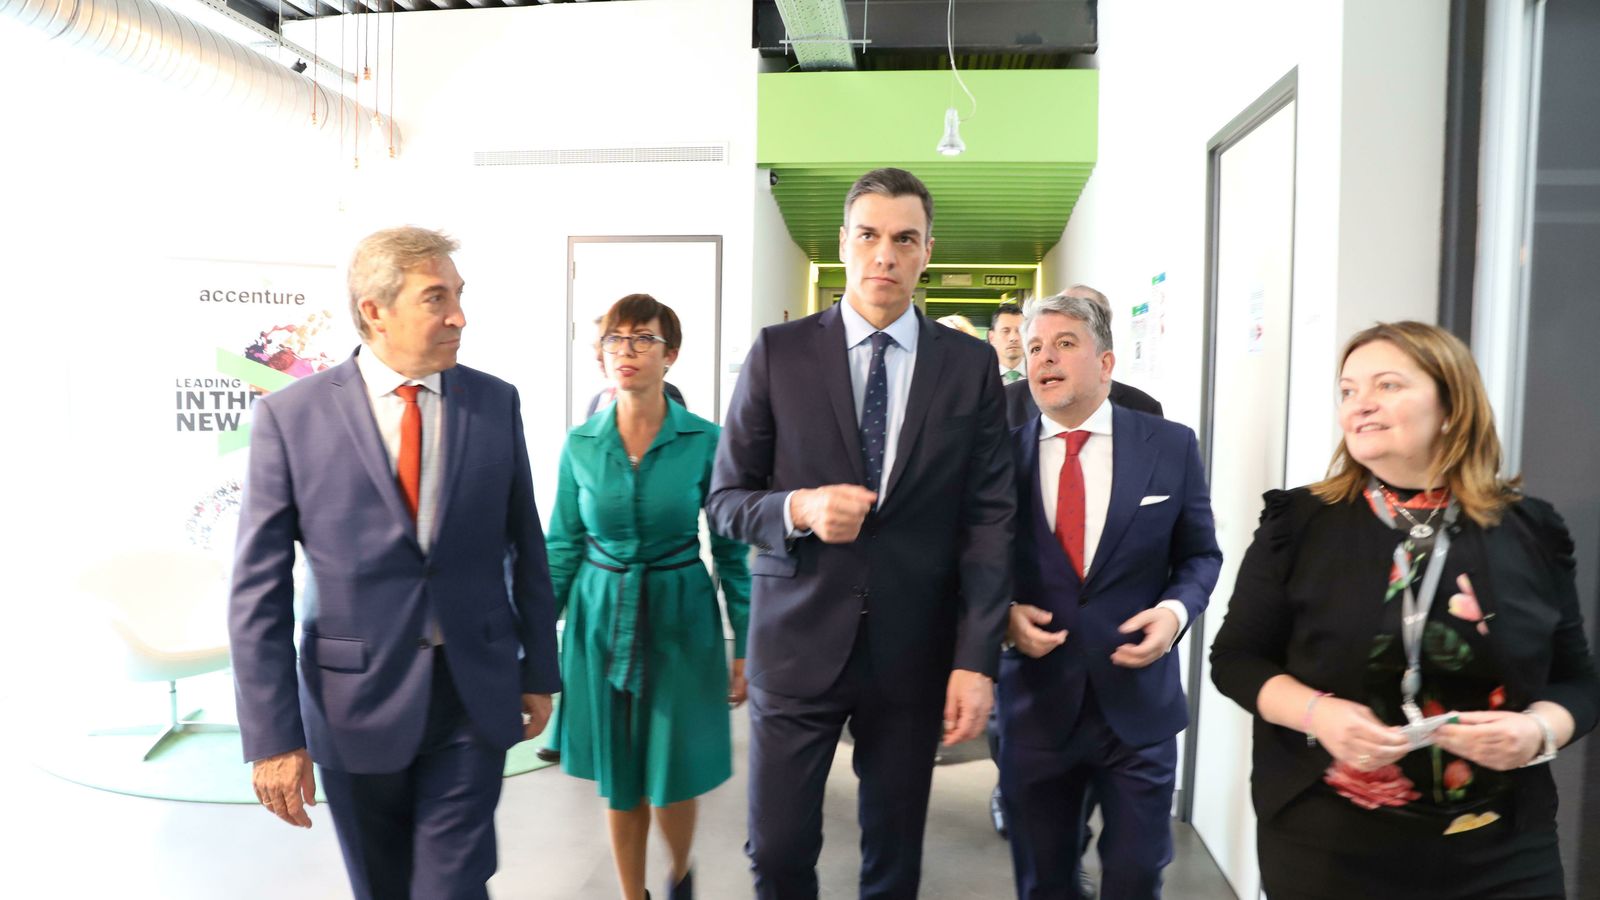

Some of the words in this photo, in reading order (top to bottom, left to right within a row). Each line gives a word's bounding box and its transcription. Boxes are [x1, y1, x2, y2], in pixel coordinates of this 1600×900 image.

[985, 276, 1016, 285] SALIDA
[200, 289, 305, 305] accenture
[176, 378, 241, 388] LEADING
[176, 391, 205, 410] IN
[176, 413, 241, 432] NEW
